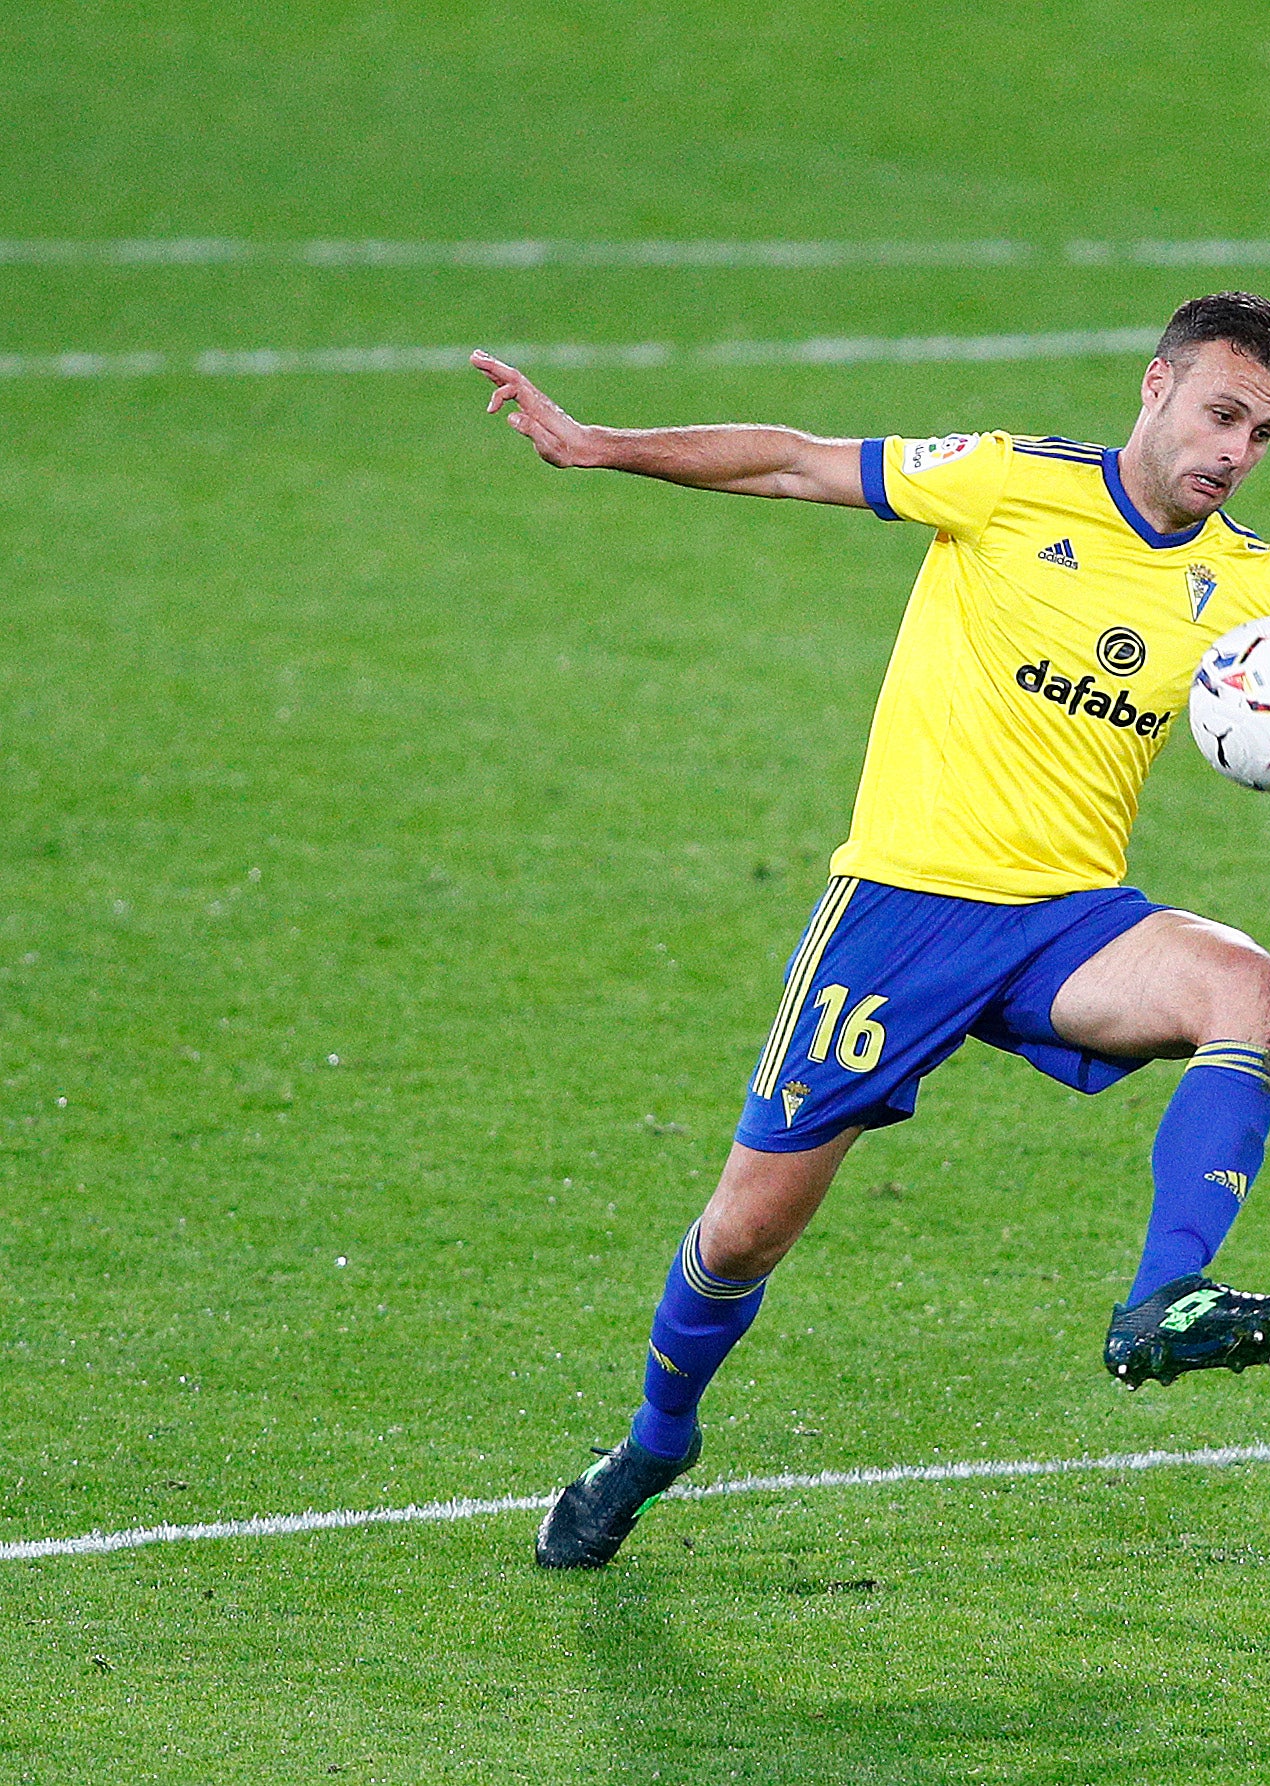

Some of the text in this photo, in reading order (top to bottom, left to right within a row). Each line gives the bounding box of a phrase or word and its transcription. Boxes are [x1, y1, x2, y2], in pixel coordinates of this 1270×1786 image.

[1037, 551, 1078, 570] adidas
[1016, 660, 1171, 739] dafabet
[807, 983, 887, 1073] 16
